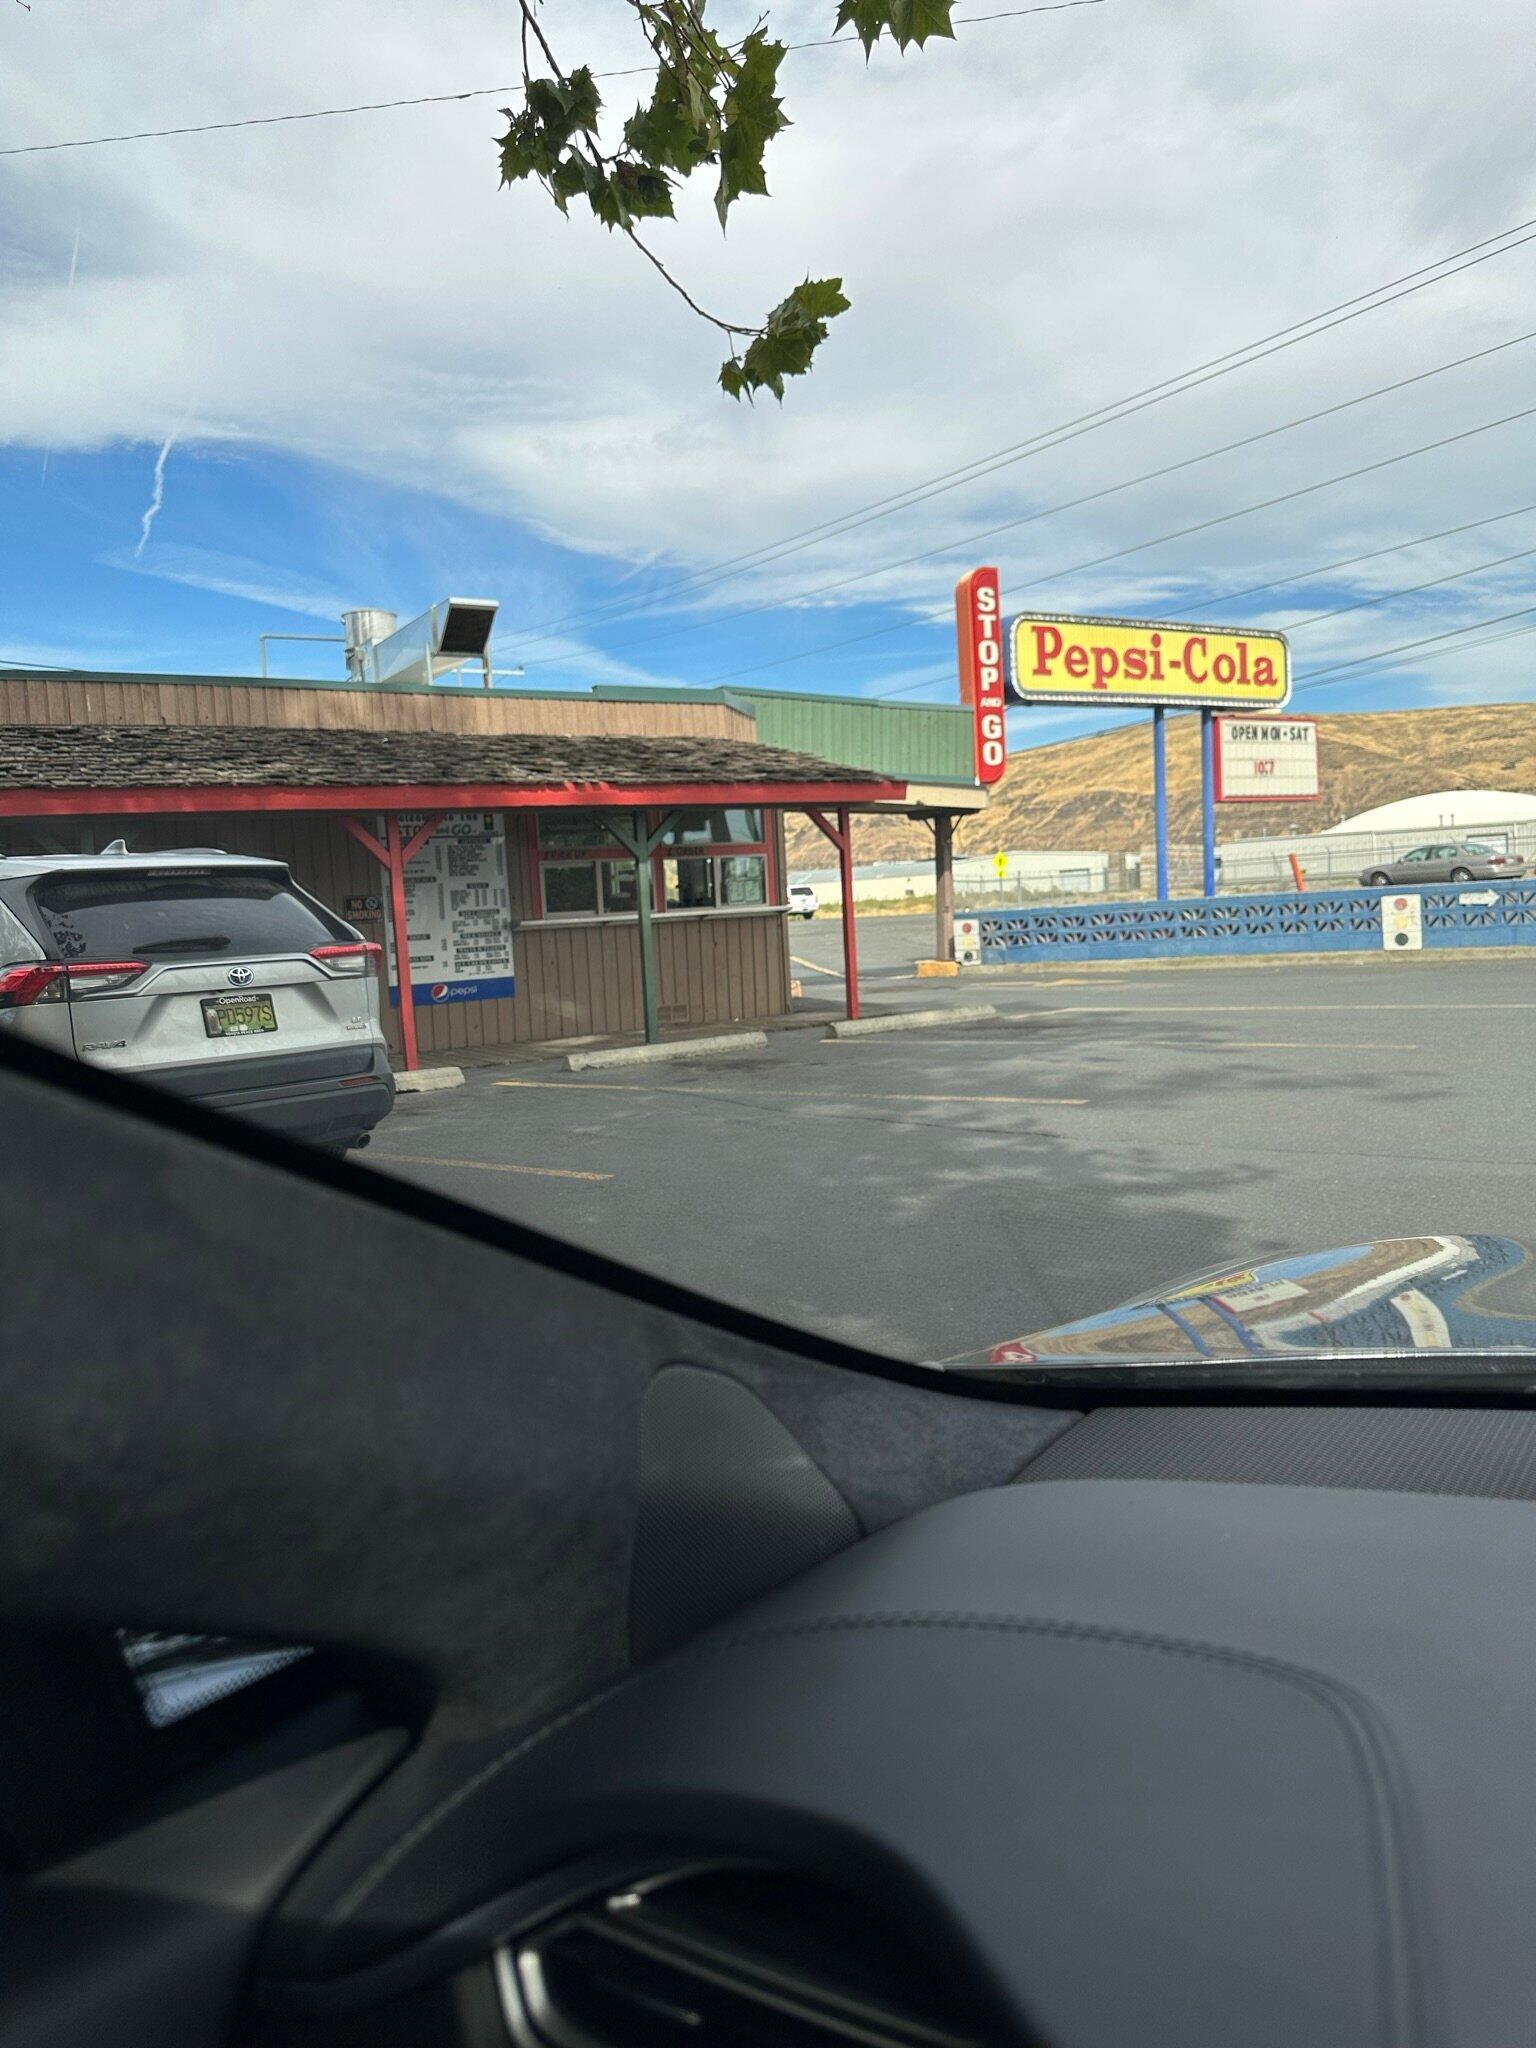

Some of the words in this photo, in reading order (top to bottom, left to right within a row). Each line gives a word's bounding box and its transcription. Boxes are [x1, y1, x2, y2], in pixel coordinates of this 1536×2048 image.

[976, 586, 999, 691] STOP
[1031, 626, 1278, 689] Pepsi-Cola
[980, 697, 1002, 708] AND
[1231, 726, 1258, 740] OPEN
[981, 714, 1004, 766] GO
[451, 823, 472, 835] GO
[351, 900, 363, 909] NO
[347, 910, 381, 920] SMOKING
[219, 995, 257, 1005] OpenRoad
